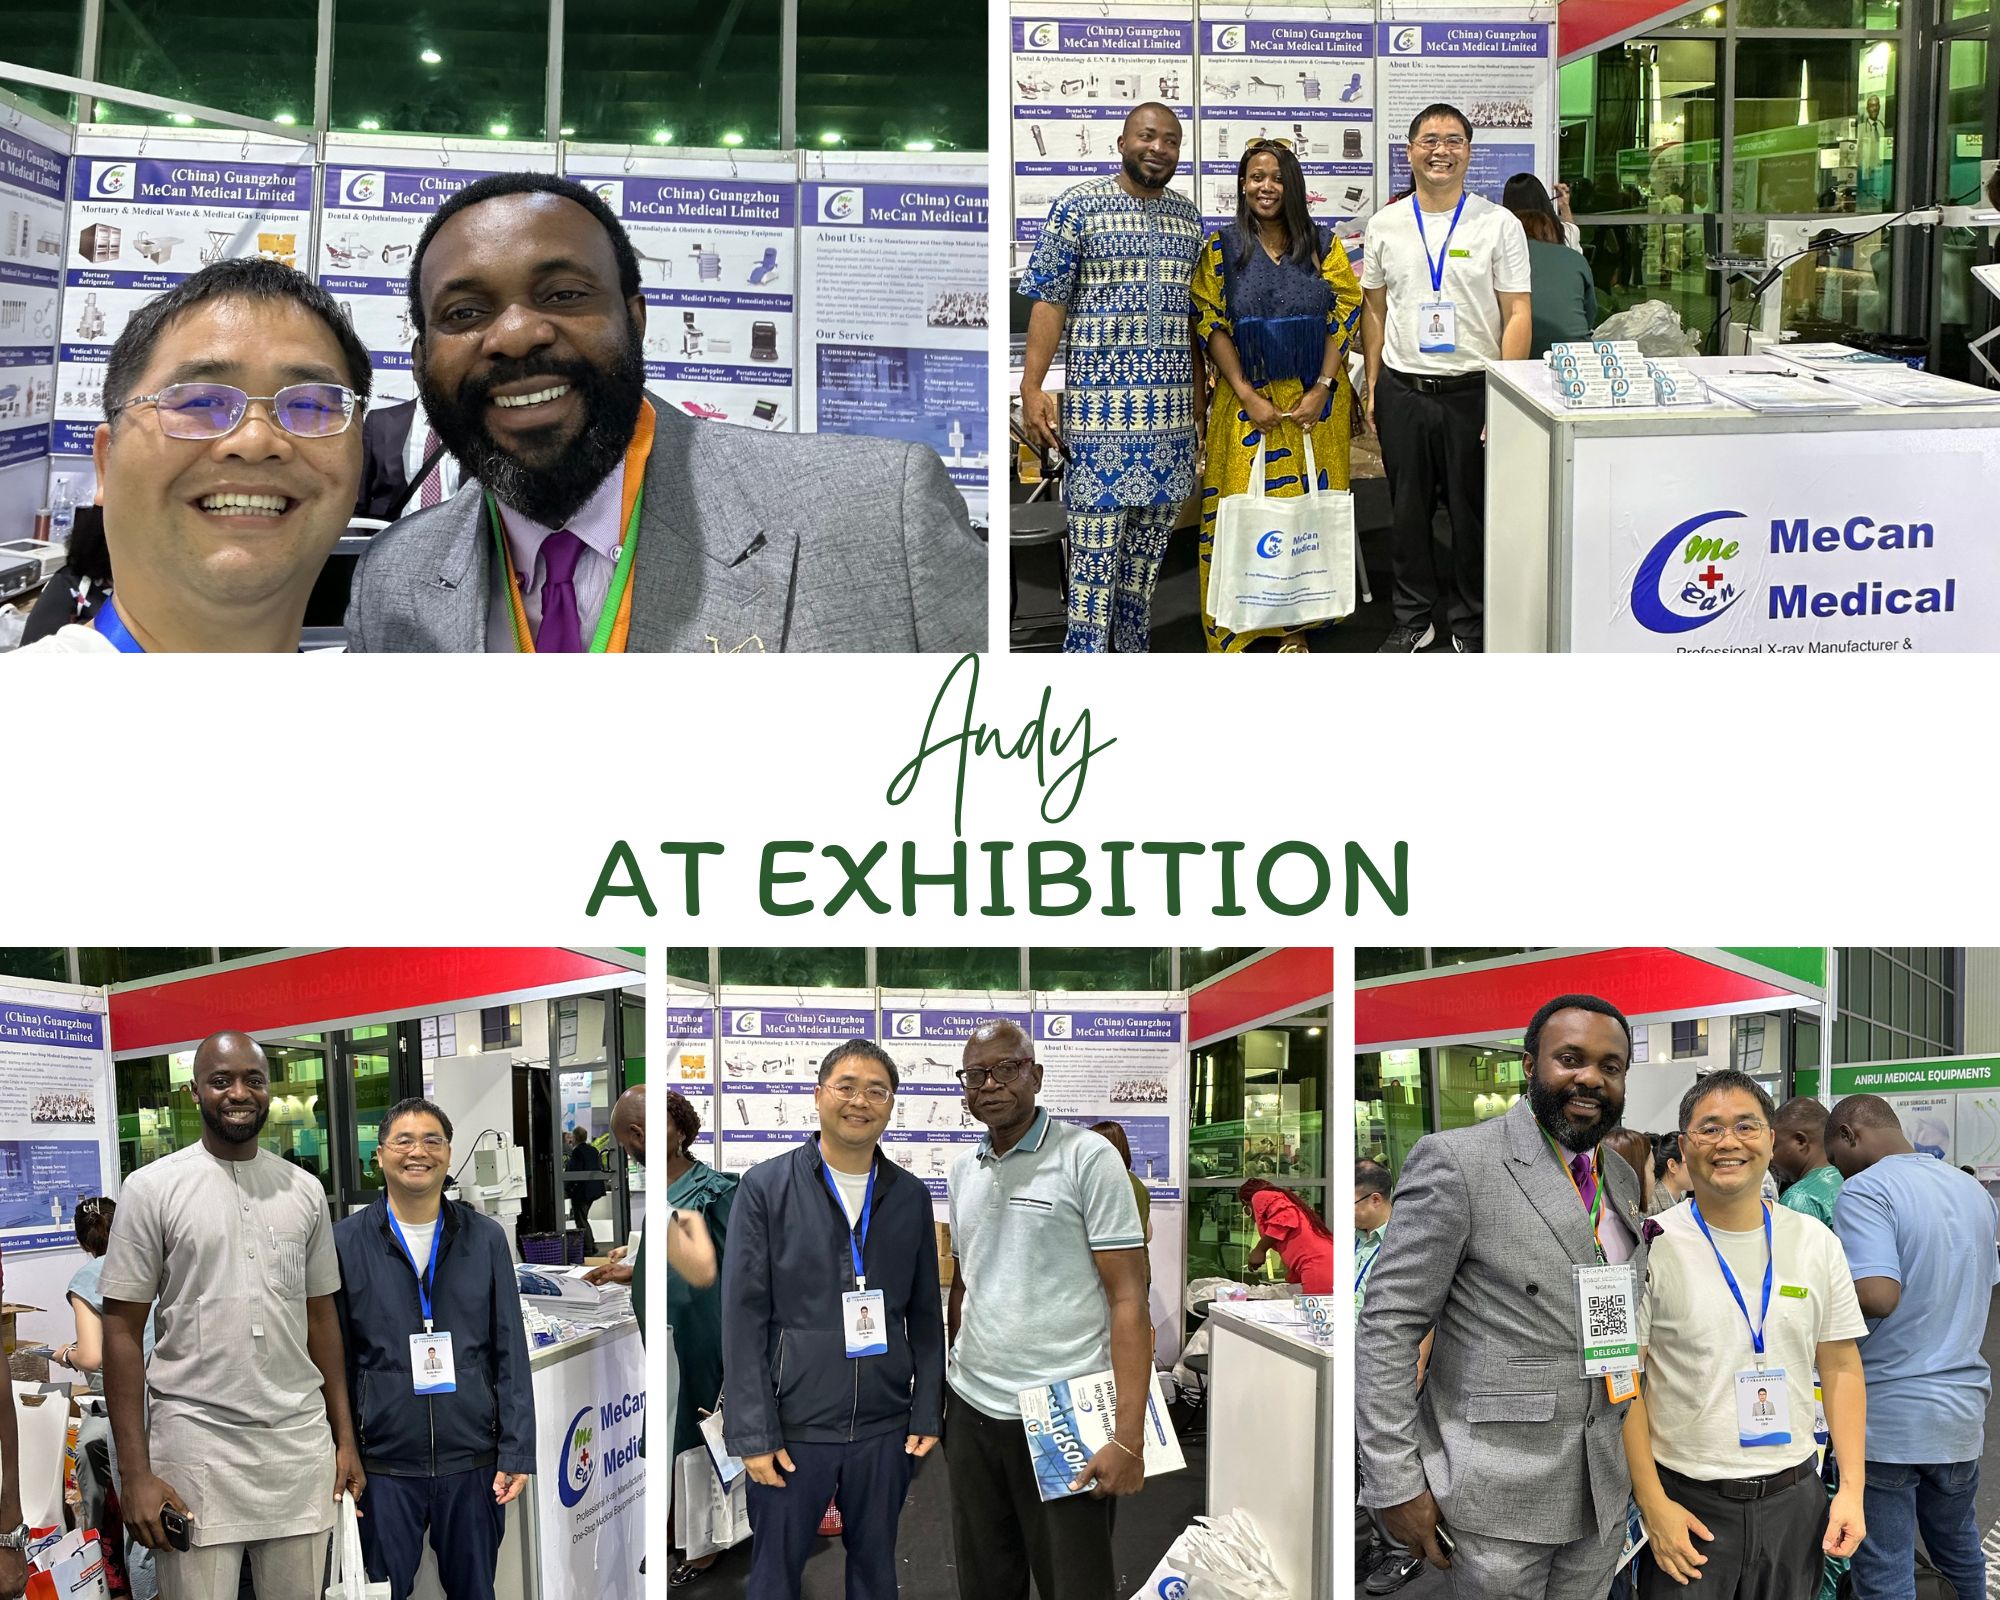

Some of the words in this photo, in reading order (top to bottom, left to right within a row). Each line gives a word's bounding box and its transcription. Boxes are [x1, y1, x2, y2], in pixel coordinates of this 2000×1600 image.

[1086, 26, 1124, 36] (China)
[1126, 26, 1180, 38] Guangzhou
[1272, 29, 1307, 40] (China)
[1310, 30, 1362, 41] Guangzhou
[1448, 30, 1482, 40] (China)
[1486, 30, 1536, 40] Guangzhou
[1064, 39, 1099, 48] MeCan
[1102, 40, 1140, 48] Medical
[1144, 40, 1180, 49] Limited
[1250, 40, 1284, 50] MeCan
[1287, 41, 1324, 50] Medical
[1327, 42, 1362, 52] Limited
[1426, 42, 1458, 50] MeCan
[1462, 42, 1499, 51] Medical
[1502, 42, 1536, 52] Limited
[26, 149, 62, 175] Guangzhou
[8, 160, 34, 183] Medical
[36, 172, 60, 192] Limited
[172, 168, 220, 184] (China)
[224, 171, 296, 188] Guangzhou
[420, 178, 466, 191] (China)
[141, 184, 186, 198] MeCan
[192, 186, 241, 200] Medical
[246, 187, 296, 202] Limited
[390, 192, 434, 206] MeCan
[658, 187, 705, 202] (China)
[709, 188, 780, 205] Guangzhou
[900, 193, 950, 208] (China)
[82, 205, 118, 216] Mortuary
[132, 206, 164, 216] Medical
[166, 208, 190, 217] Waste
[193, 209, 200, 217] &
[202, 210, 236, 219] Medical
[238, 211, 253, 220] Gas
[255, 212, 300, 222] Equipment
[630, 201, 673, 214] MeCan
[678, 202, 727, 216] Medical
[731, 206, 780, 220] Limited
[870, 208, 916, 222] MeCan
[922, 210, 973, 224] Medical
[328, 212, 350, 220] Dental
[362, 214, 416, 224] Ophthalmology
[752, 230, 783, 238] Equipment
[817, 232, 846, 243] About
[850, 233, 866, 243] Us:
[79, 278, 115, 286] Refrigerator
[82, 272, 110, 280] Mortuary
[144, 274, 167, 282] Forensic
[326, 280, 348, 288] Dental
[349, 281, 368, 289] Chair
[661, 293, 674, 301] Bed
[681, 294, 706, 302] Medical
[708, 295, 731, 304] Trolley
[737, 298, 774, 306] Hemodialysis
[816, 329, 835, 340] Our
[838, 330, 874, 341] Service
[73, 354, 106, 362] Incinerator
[383, 356, 397, 364] Slit
[676, 372, 708, 382] Ultrasound
[709, 374, 732, 383] Scanner
[684, 367, 701, 375] Color
[702, 368, 725, 376] Doppler
[64, 441, 82, 450] Web:
[1293, 532, 1318, 545] MeCan
[1770, 516, 1934, 554] MeCan
[1292, 542, 1320, 557] Medical
[1768, 579, 1956, 619] Medical
[1808, 640, 1899, 653] Manufacturer
[1902, 637, 1912, 650] &
[6, 1011, 41, 1026] (China)
[44, 1016, 92, 1030] Guangzhou
[784, 1013, 816, 1024] (China)
[818, 1014, 865, 1025] Guangzhou
[943, 1016, 974, 1026] (China)
[1094, 1018, 1124, 1028] (China)
[1127, 1018, 1170, 1028] Guangzhou
[22, 1026, 58, 1040] Medical
[60, 1030, 93, 1043] Limited
[670, 1025, 702, 1034] Limited
[766, 1024, 796, 1034] MeCan
[800, 1025, 830, 1034] Medical
[833, 1025, 865, 1034] Limited
[924, 1026, 954, 1036] MeCan
[1076, 1029, 1104, 1037] MeCan
[1107, 1030, 1138, 1038] Medical
[1141, 1030, 1170, 1038] Limited
[1854, 1074, 1883, 1086] ANRUI
[1884, 1071, 1926, 1084] MEDICAL
[1928, 1066, 1991, 1082] EQUIPMENTS
[1594, 1346, 1630, 1358] DELEGATE
[1094, 1384, 1106, 1412] MeCan
[576, 1496, 606, 1524] Professional
[606, 1490, 618, 1502] X-ray
[618, 1474, 643, 1496] Manufacturer
[572, 1522, 596, 1544] One-Stop
[597, 1510, 614, 1527] Medical
[614, 1494, 636, 1516] Equipment
